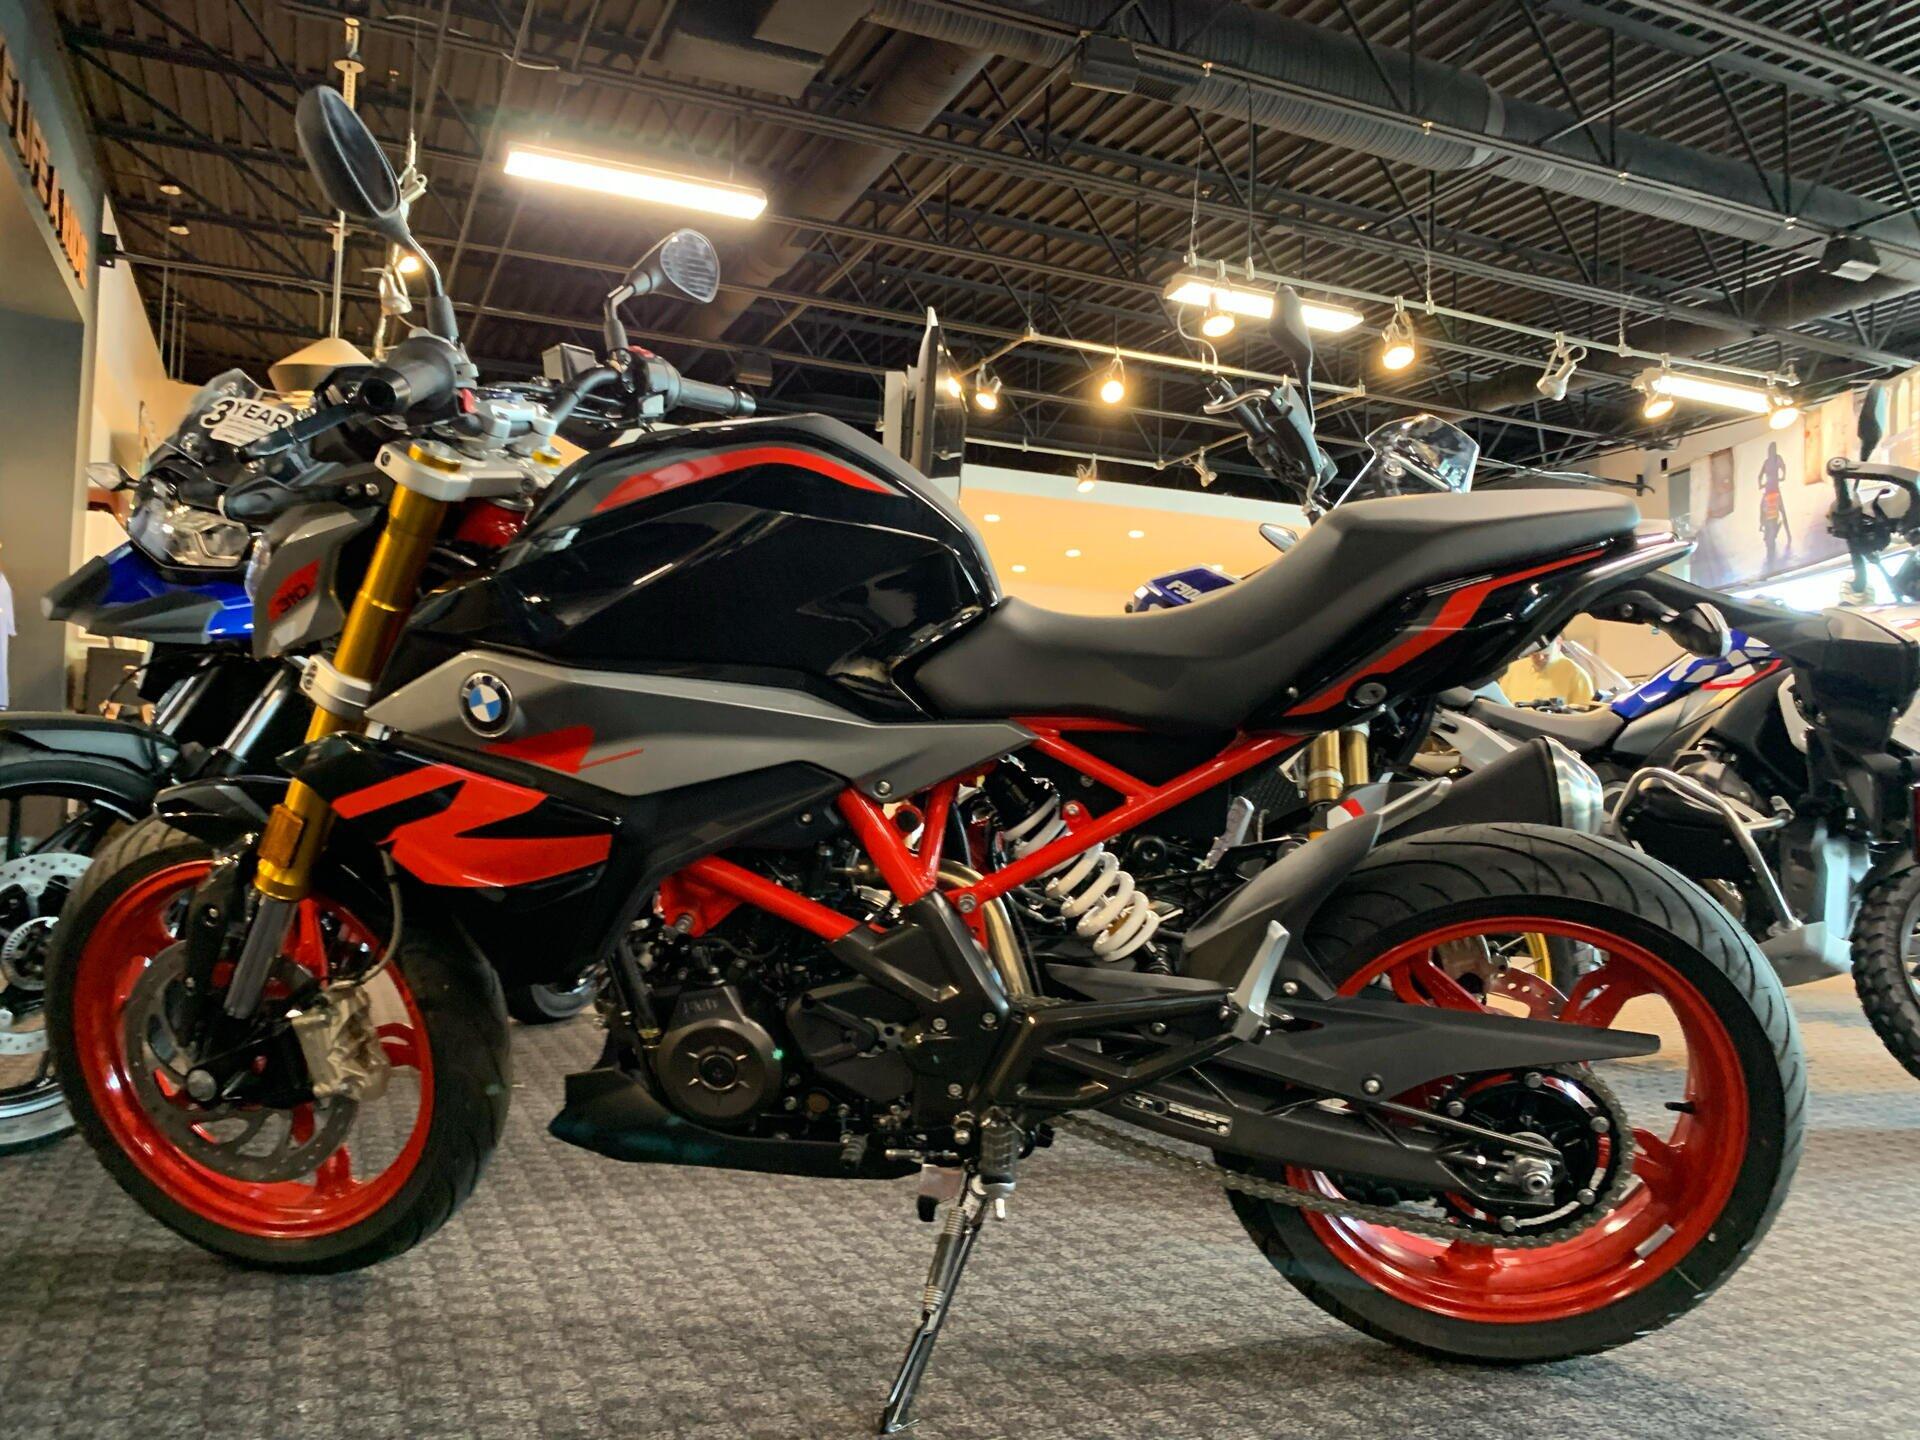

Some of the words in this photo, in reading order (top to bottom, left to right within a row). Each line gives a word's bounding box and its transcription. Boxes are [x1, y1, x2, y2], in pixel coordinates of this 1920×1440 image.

[204, 399, 236, 426] 3
[233, 402, 288, 427] YEAR
[275, 582, 310, 614] 310
